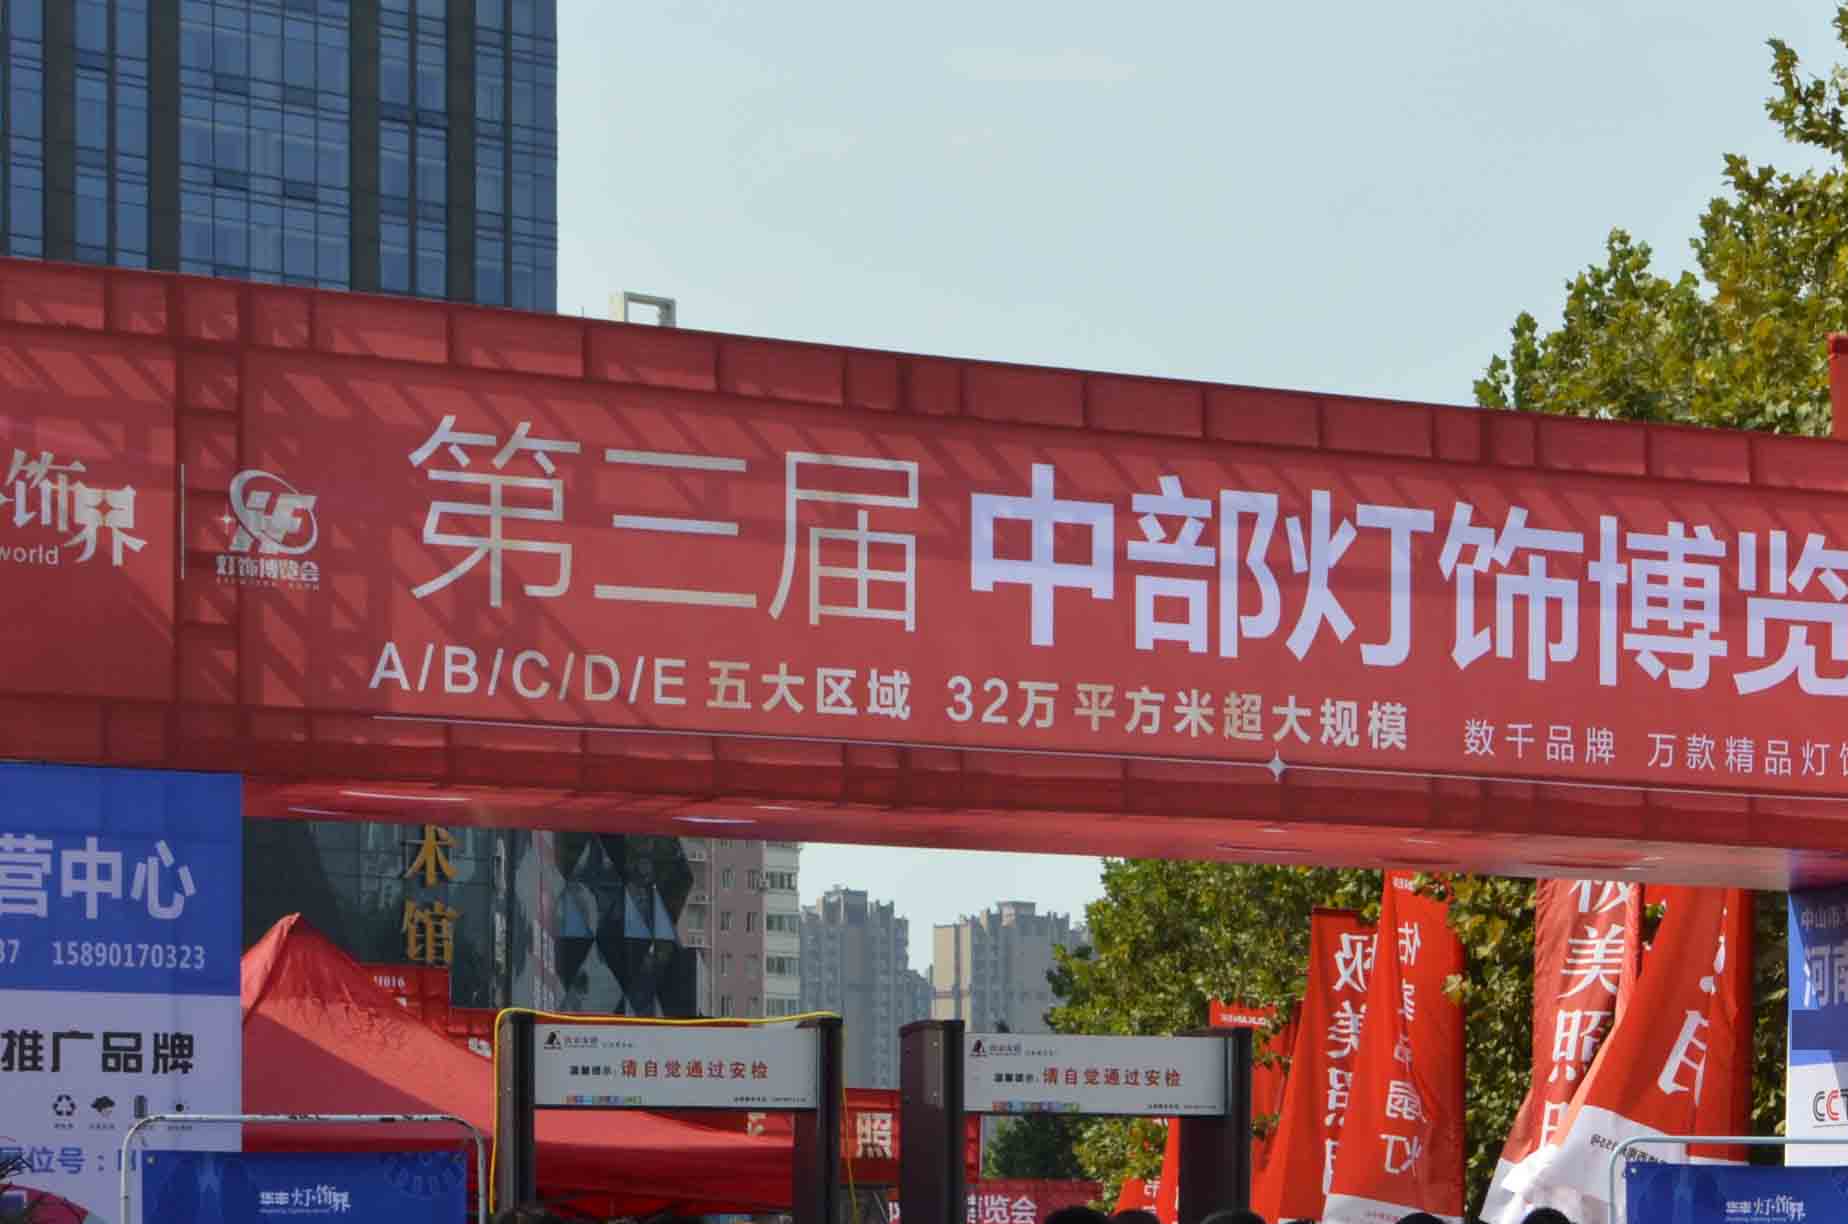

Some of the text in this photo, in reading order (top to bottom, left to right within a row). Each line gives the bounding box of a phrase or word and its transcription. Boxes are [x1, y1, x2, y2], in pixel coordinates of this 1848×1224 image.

[408, 414, 919, 633] 第三届
[368, 640, 1409, 751] A/B/C/D/E 五大区域 32万平方米超大规模
[1462, 719, 1616, 766] 数千品牌
[0, 833, 197, 919] 营中心
[52, 941, 207, 970] 15890170323
[1, 1030, 196, 1074] 推广品牌
[621, 1059, 769, 1080] 请自觉通过安检
[1043, 1066, 1182, 1088] 请自觉通过安检
